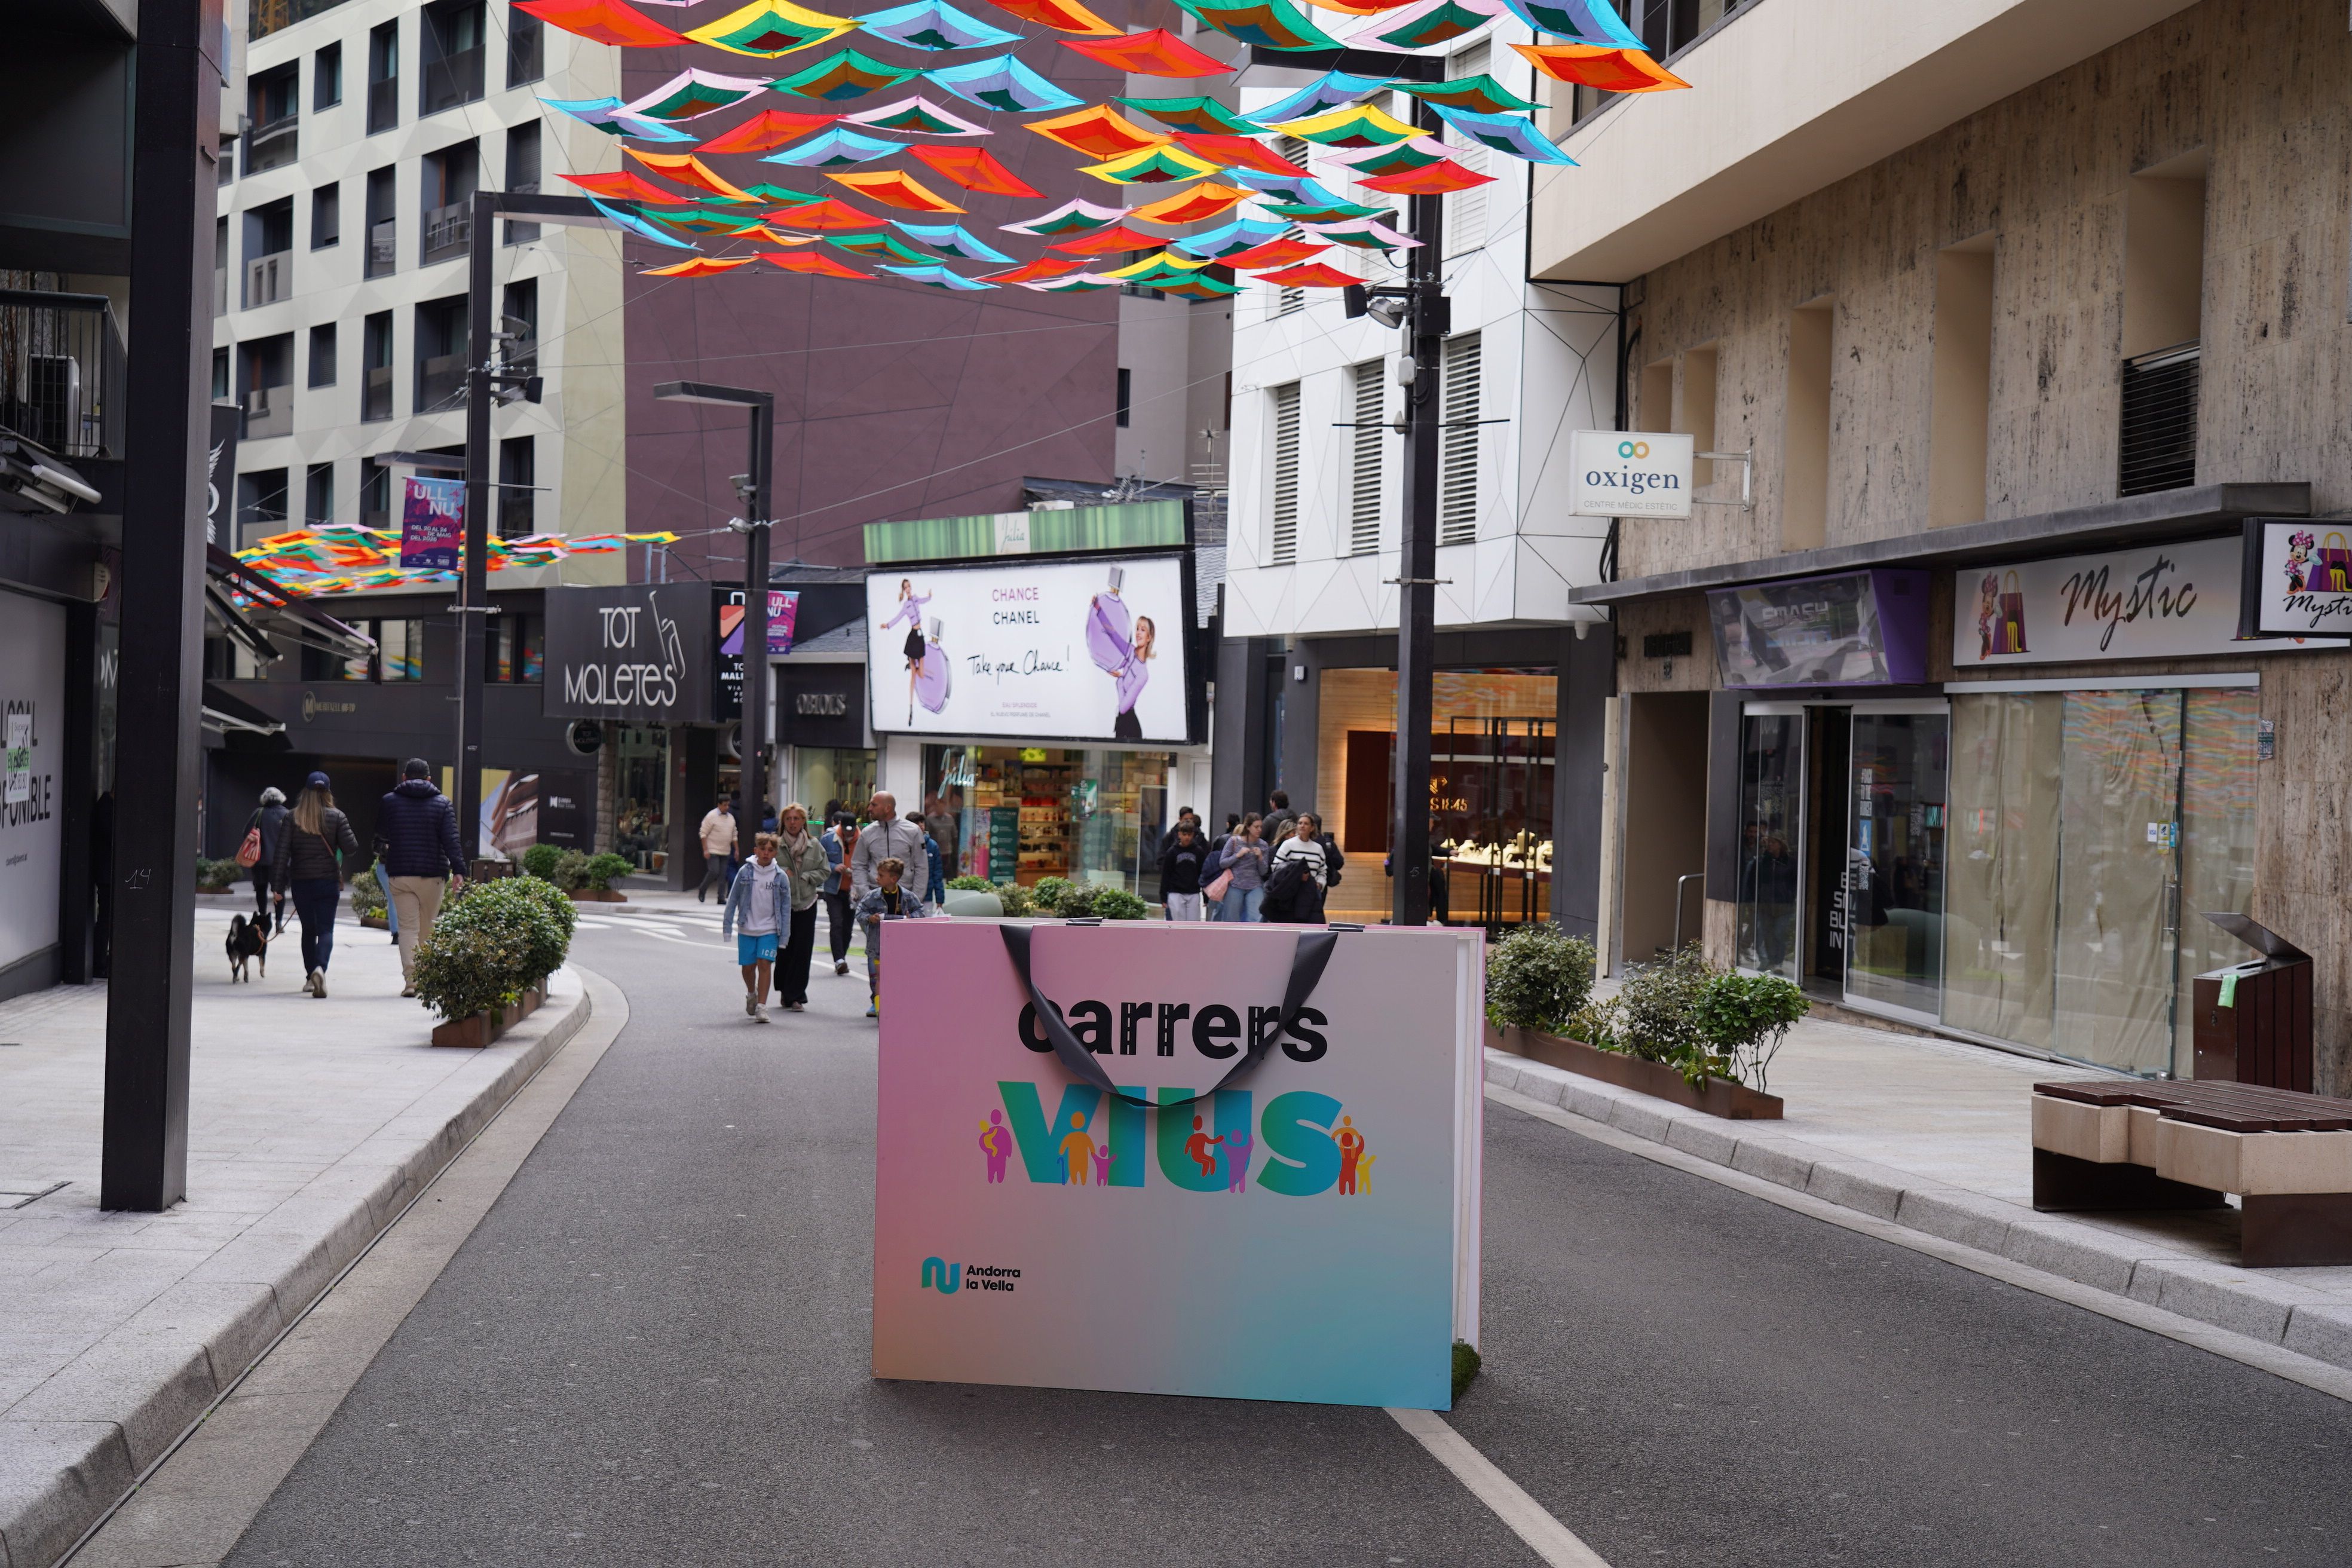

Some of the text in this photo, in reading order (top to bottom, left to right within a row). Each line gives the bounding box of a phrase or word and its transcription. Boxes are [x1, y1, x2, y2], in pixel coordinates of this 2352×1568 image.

[1585, 464, 1680, 494] oxigen
[414, 484, 448, 501] ULL
[428, 501, 455, 516] NU
[771, 596, 792, 608] ULL
[993, 587, 1039, 602] CHANCE
[2060, 553, 2198, 652] Mystic
[993, 610, 1040, 625] CHANEL
[2283, 595, 2352, 629] Mysti
[599, 607, 641, 649] TOT
[967, 653, 992, 676] Take
[125, 868, 152, 889] 14
[1018, 999, 1328, 1063] carrers
[997, 1080, 1344, 1197] VIUS
[966, 1264, 1021, 1278] Andorra
[966, 1278, 1014, 1291] la Vella
